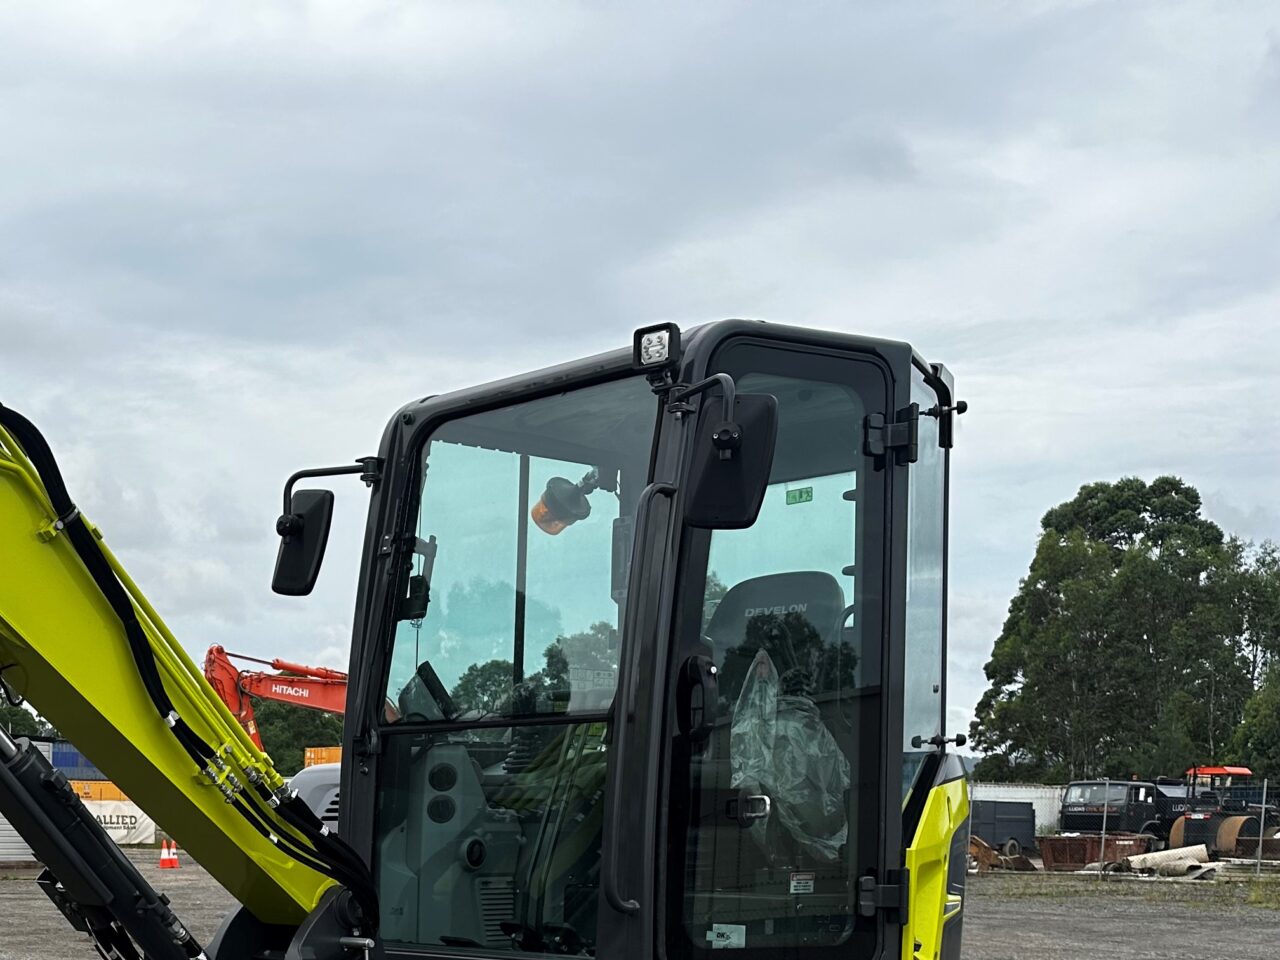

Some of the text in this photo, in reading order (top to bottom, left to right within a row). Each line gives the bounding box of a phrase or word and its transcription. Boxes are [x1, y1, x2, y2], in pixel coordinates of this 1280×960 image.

[744, 603, 807, 617] DEVELON
[271, 683, 309, 698] HITACHI
[96, 814, 137, 825] ALLIED
